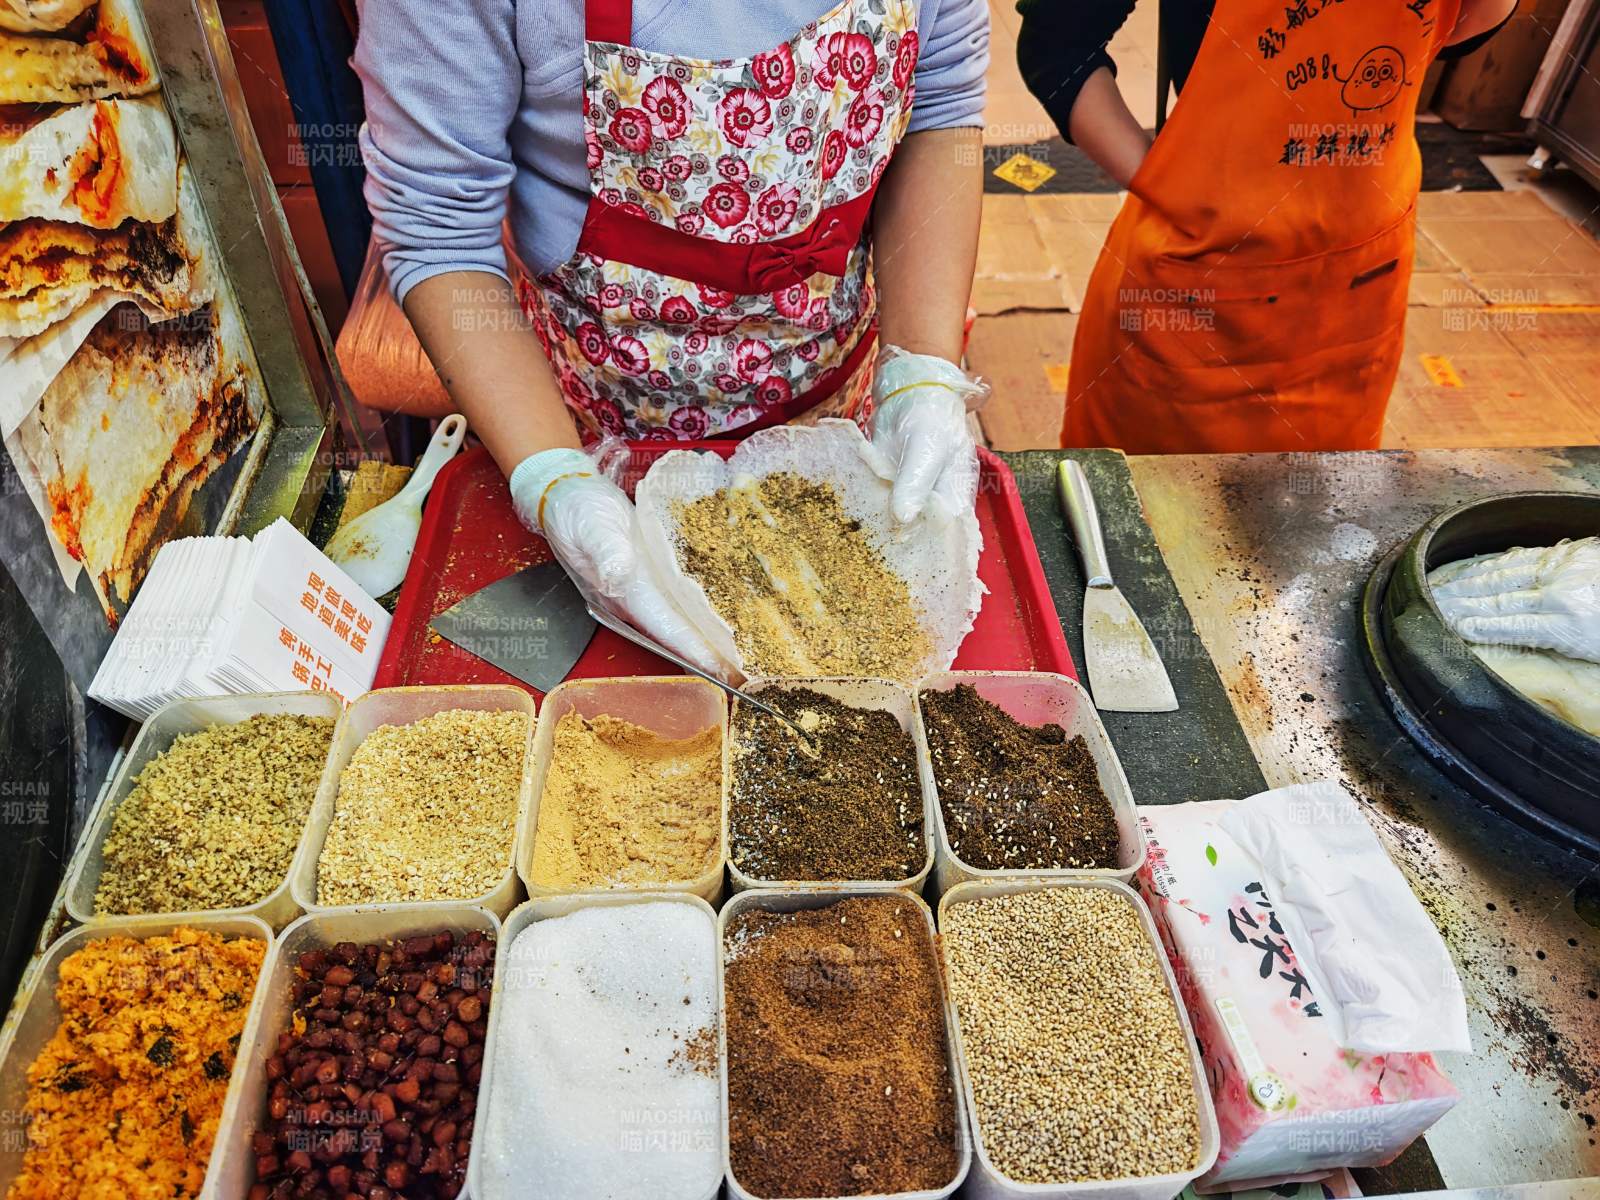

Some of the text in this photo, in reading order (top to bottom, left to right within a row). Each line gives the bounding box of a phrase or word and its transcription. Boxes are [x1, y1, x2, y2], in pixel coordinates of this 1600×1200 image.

[300, 591, 367, 654] 地道美味
[307, 571, 373, 635] 现做现吃
[279, 627, 333, 679] 纯手工
[1157, 875, 1170, 898] tissue
